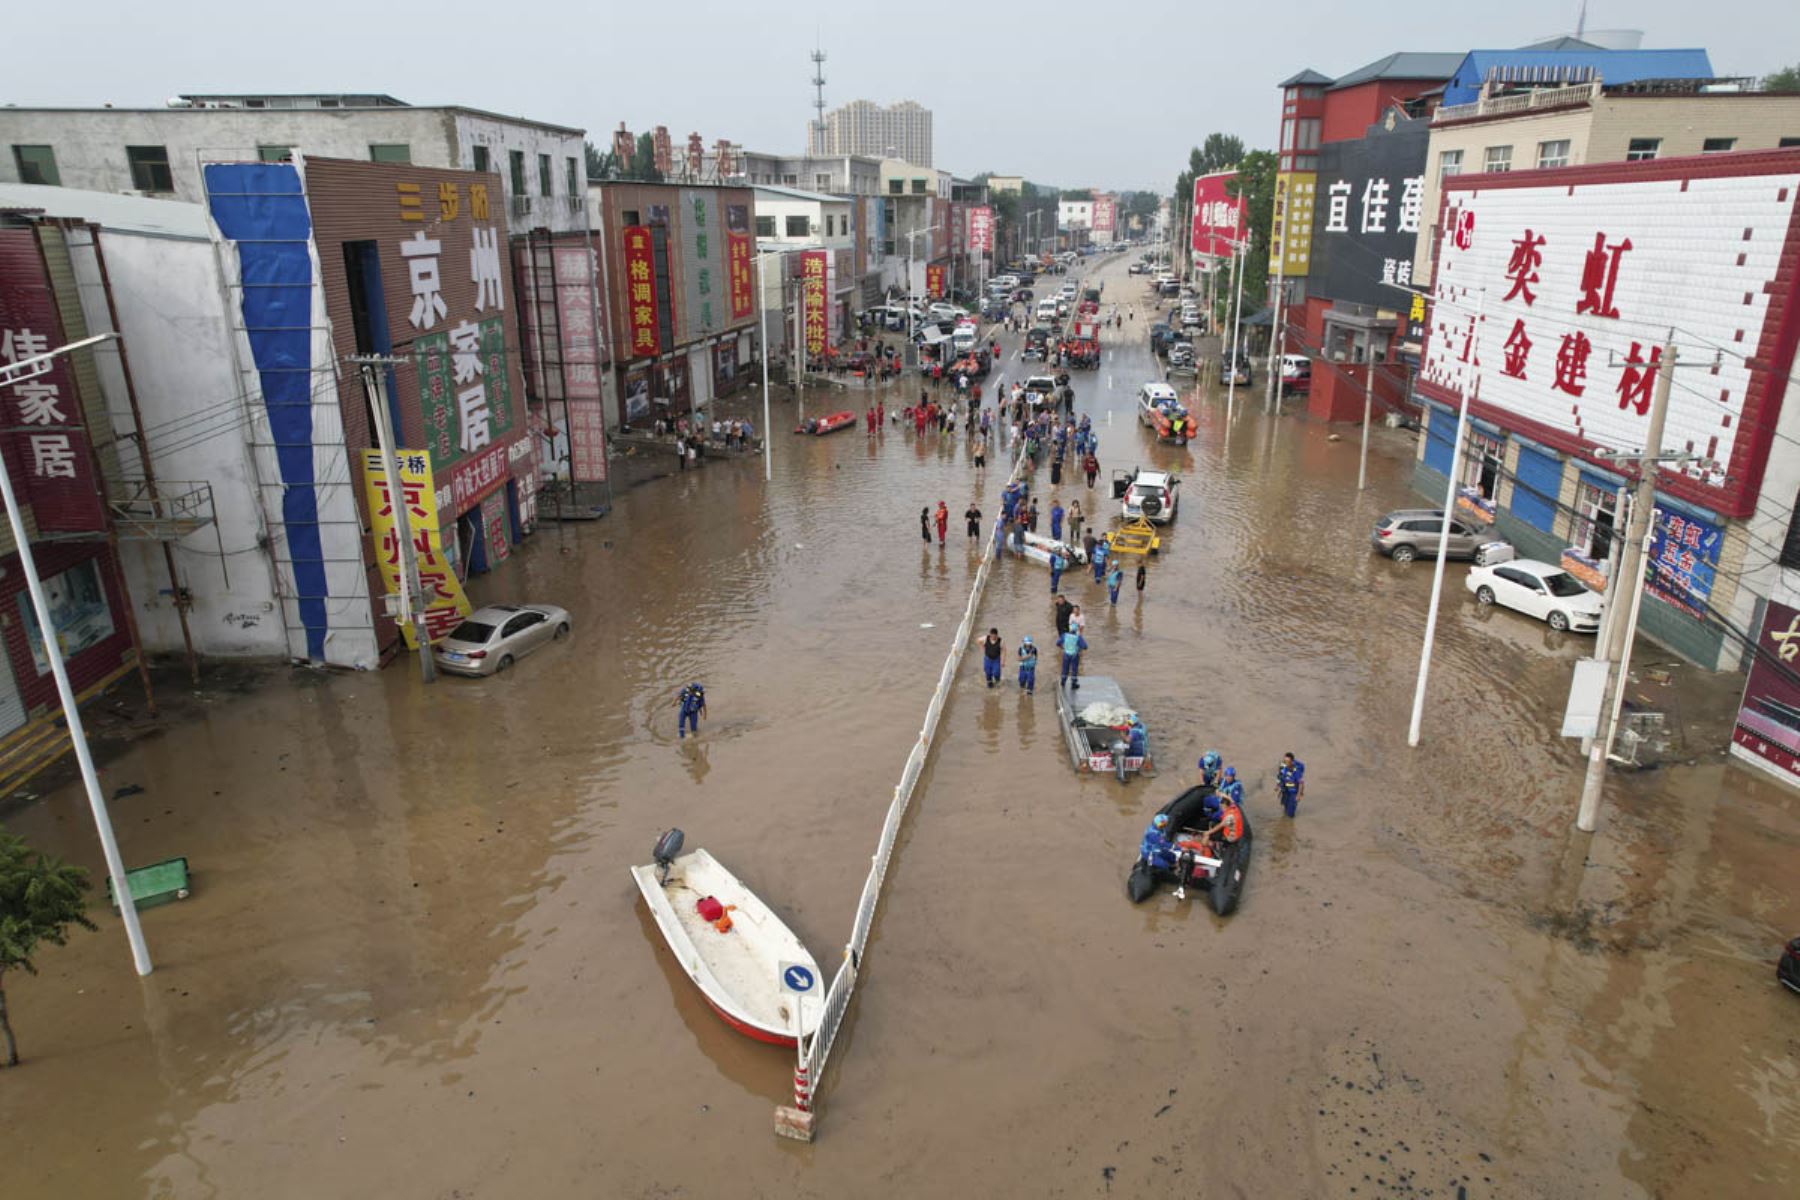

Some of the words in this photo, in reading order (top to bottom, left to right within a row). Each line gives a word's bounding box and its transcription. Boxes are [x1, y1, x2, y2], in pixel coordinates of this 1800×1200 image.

[1324, 175, 1425, 235] 宜佳建
[400, 226, 504, 330] 京州
[1502, 228, 1633, 320] 奕虹
[449, 319, 492, 453] 家居
[1456, 313, 1663, 417] 五金建材
[367, 455, 427, 475] 三桥
